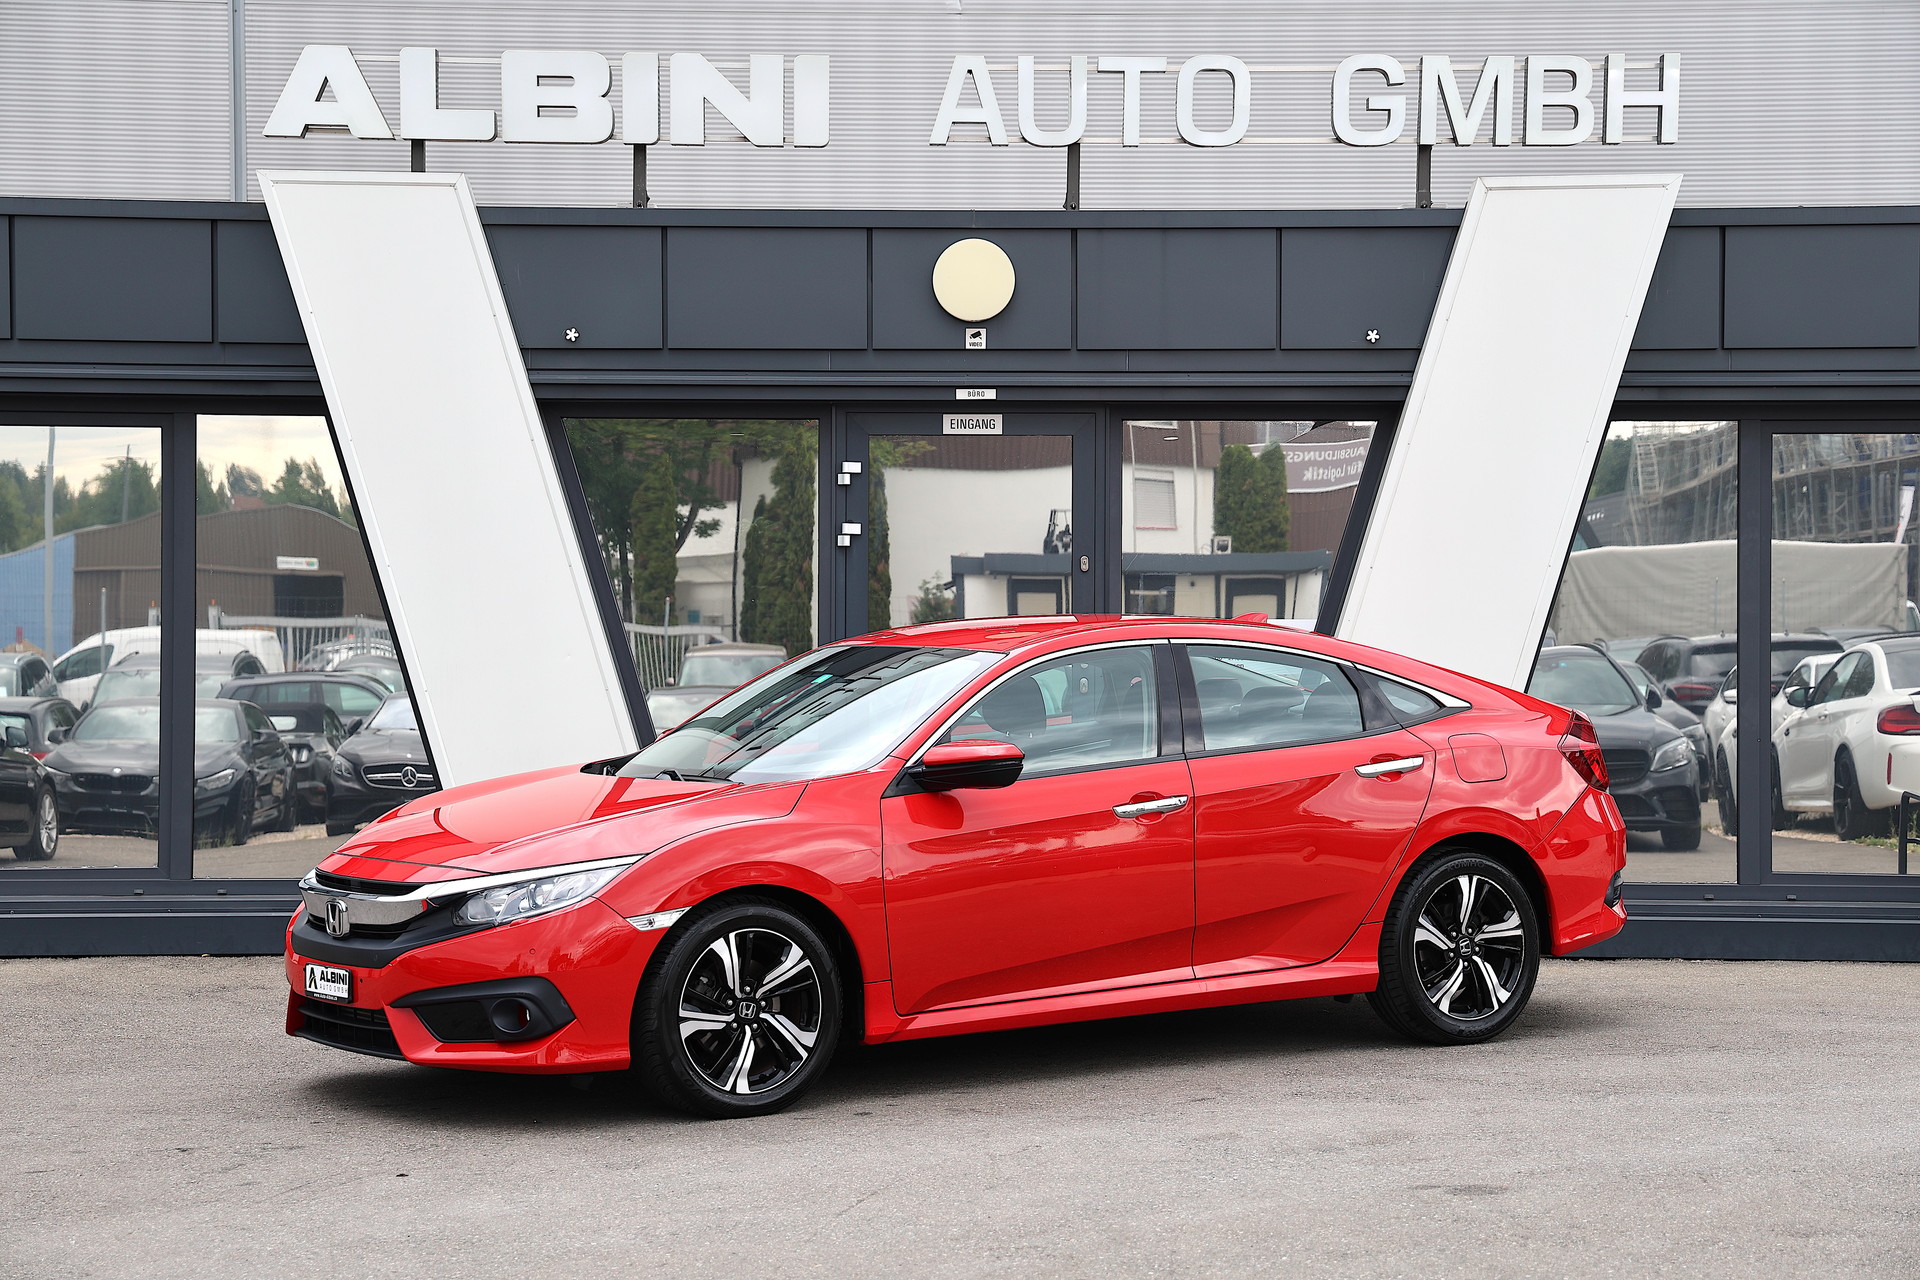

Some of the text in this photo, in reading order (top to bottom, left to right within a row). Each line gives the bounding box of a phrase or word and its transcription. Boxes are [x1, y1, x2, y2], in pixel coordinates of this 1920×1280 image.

[263, 45, 1681, 148] ALBINI AUTO GMBH
[950, 418, 996, 430] EINGANG
[1447, 860, 1485, 872] KUMHO
[320, 970, 347, 985] ALBINI
